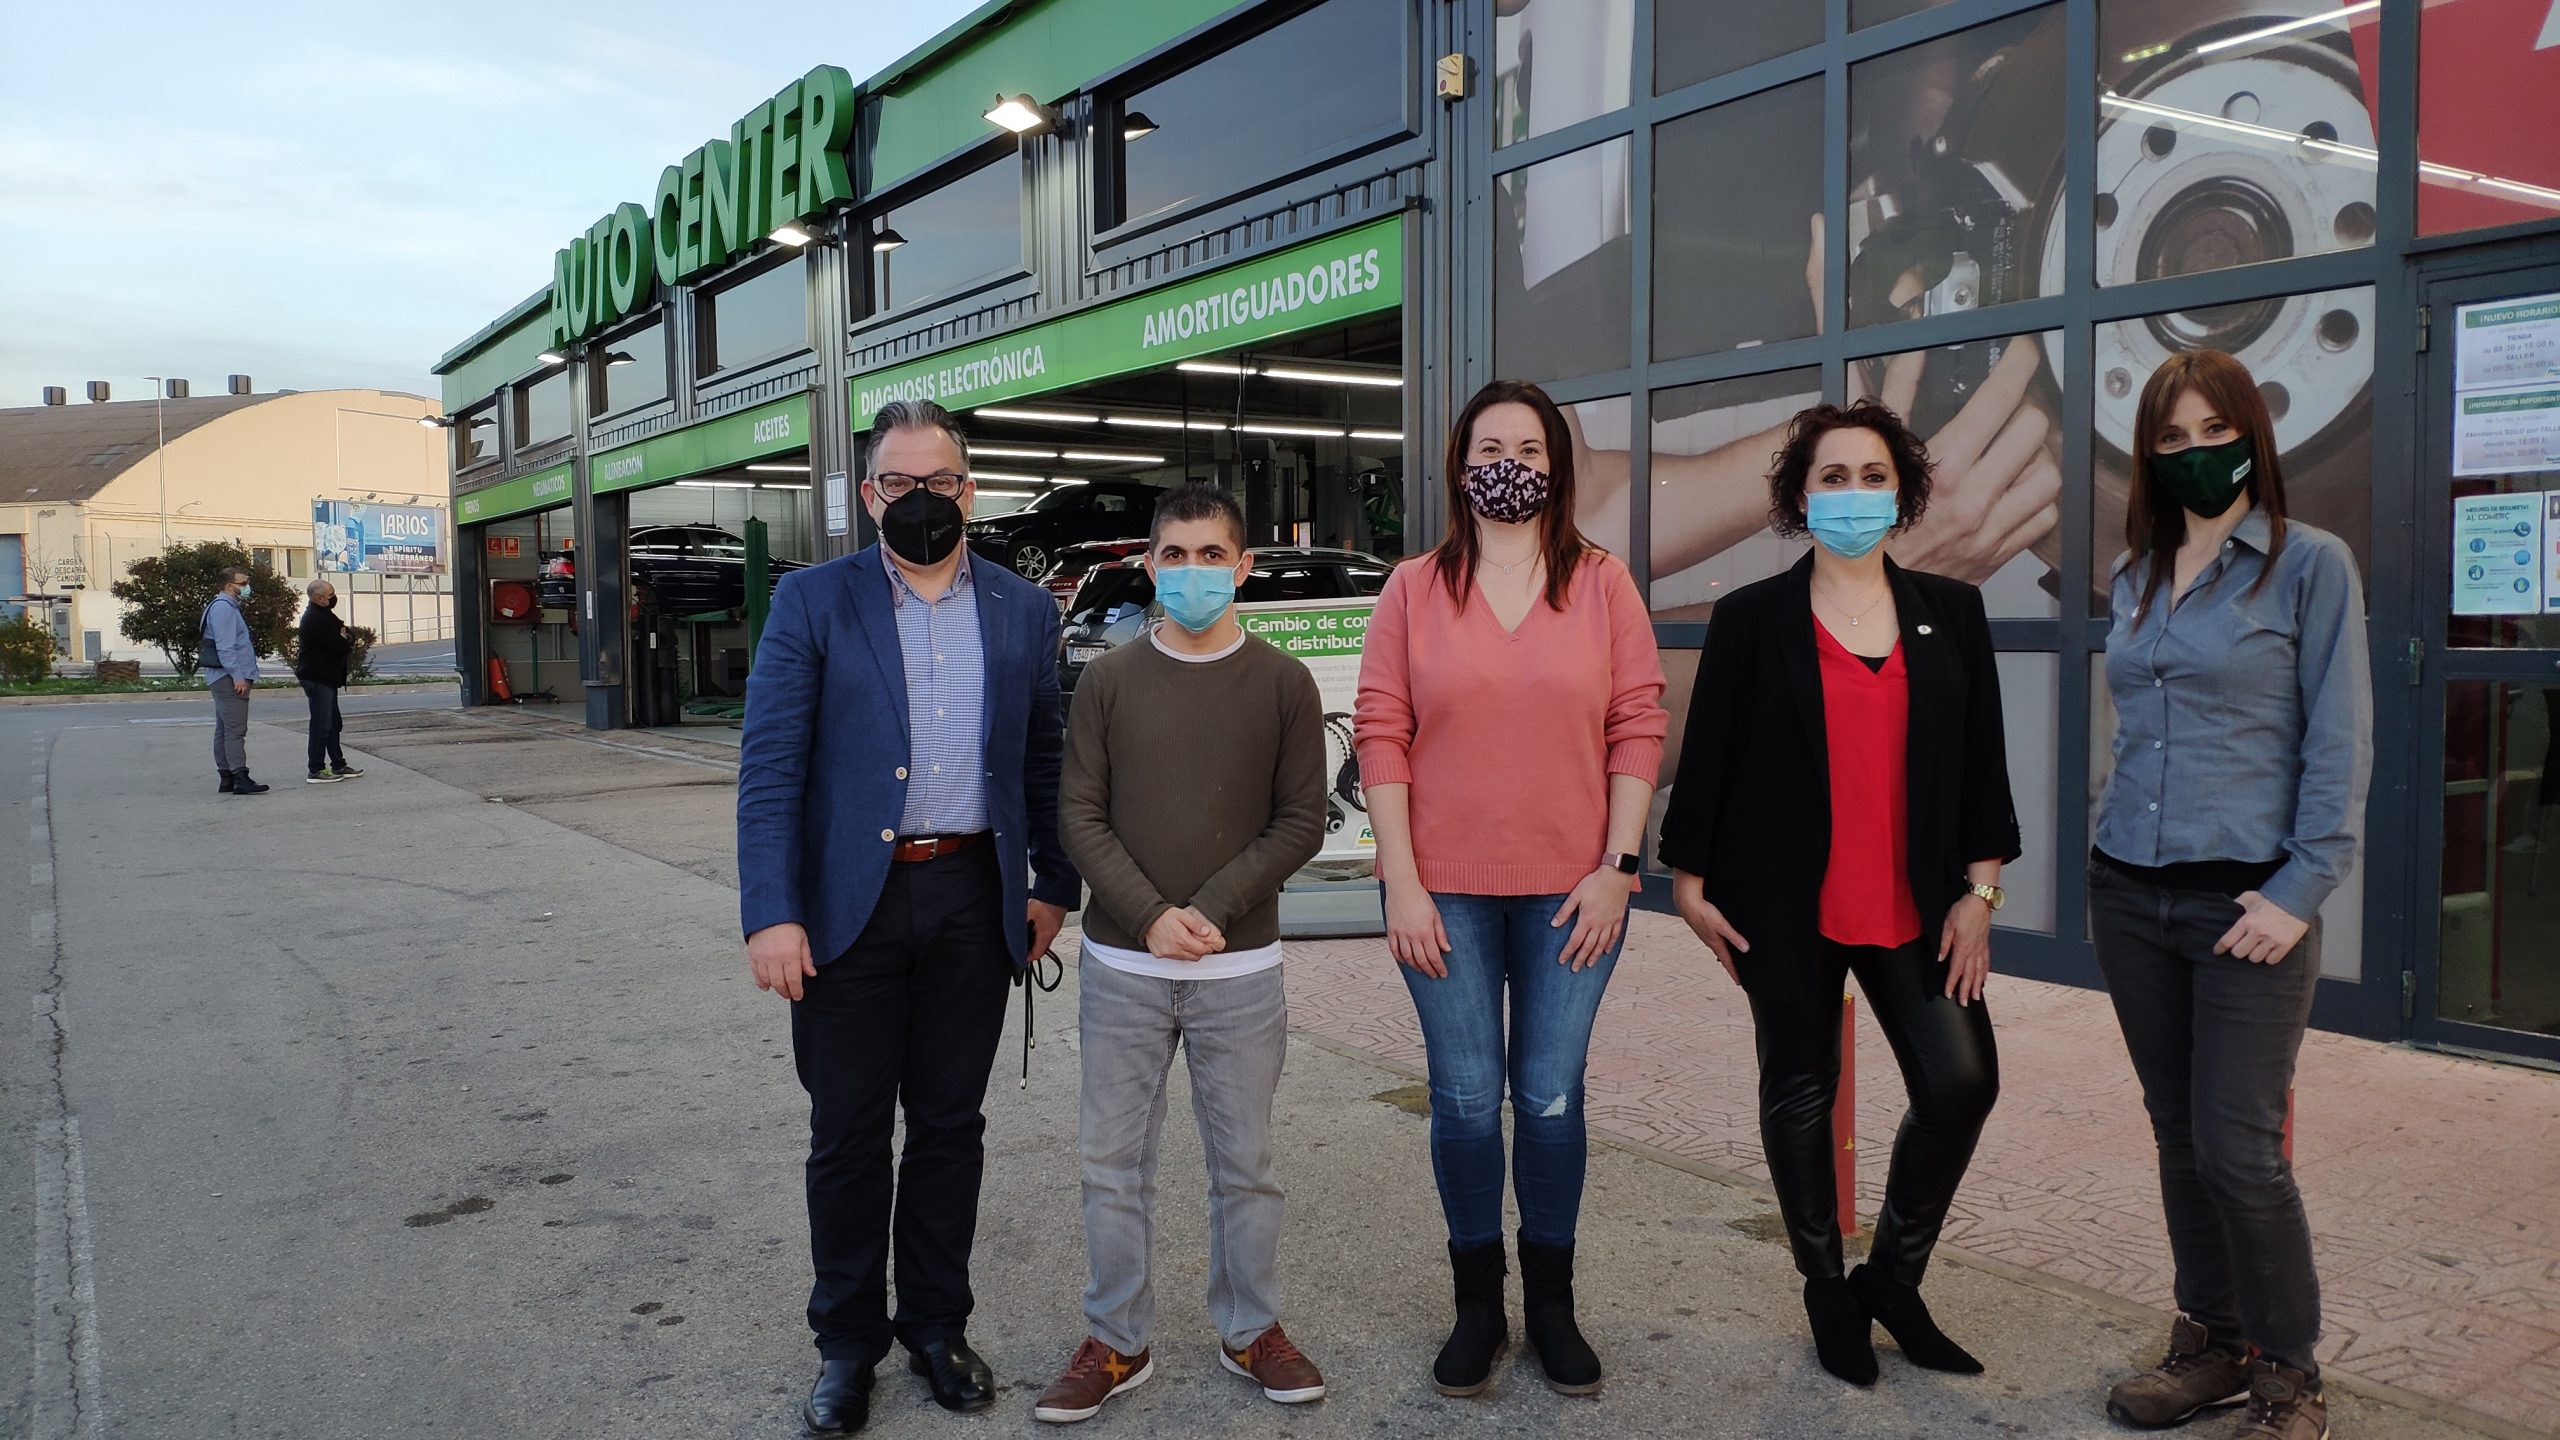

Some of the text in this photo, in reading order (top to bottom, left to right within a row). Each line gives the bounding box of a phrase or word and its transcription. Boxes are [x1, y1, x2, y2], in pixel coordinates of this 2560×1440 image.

[549, 64, 854, 347] AUTO CENTER
[1142, 248, 1380, 349] AMORTIGUADORES
[861, 345, 1046, 416] DIAGNOSIS ELECTRÓNICA
[754, 413, 790, 444] ACEITES
[604, 451, 643, 482] ALINEACIÓN
[464, 498, 480, 515] FRENOS
[381, 513, 429, 540] LARIOS
[379, 554, 434, 562] MEDITERRÁNEO
[389, 545, 423, 553] ESPÍRITU
[1246, 616, 1311, 632] Cambio
[1316, 614, 1337, 629] de
